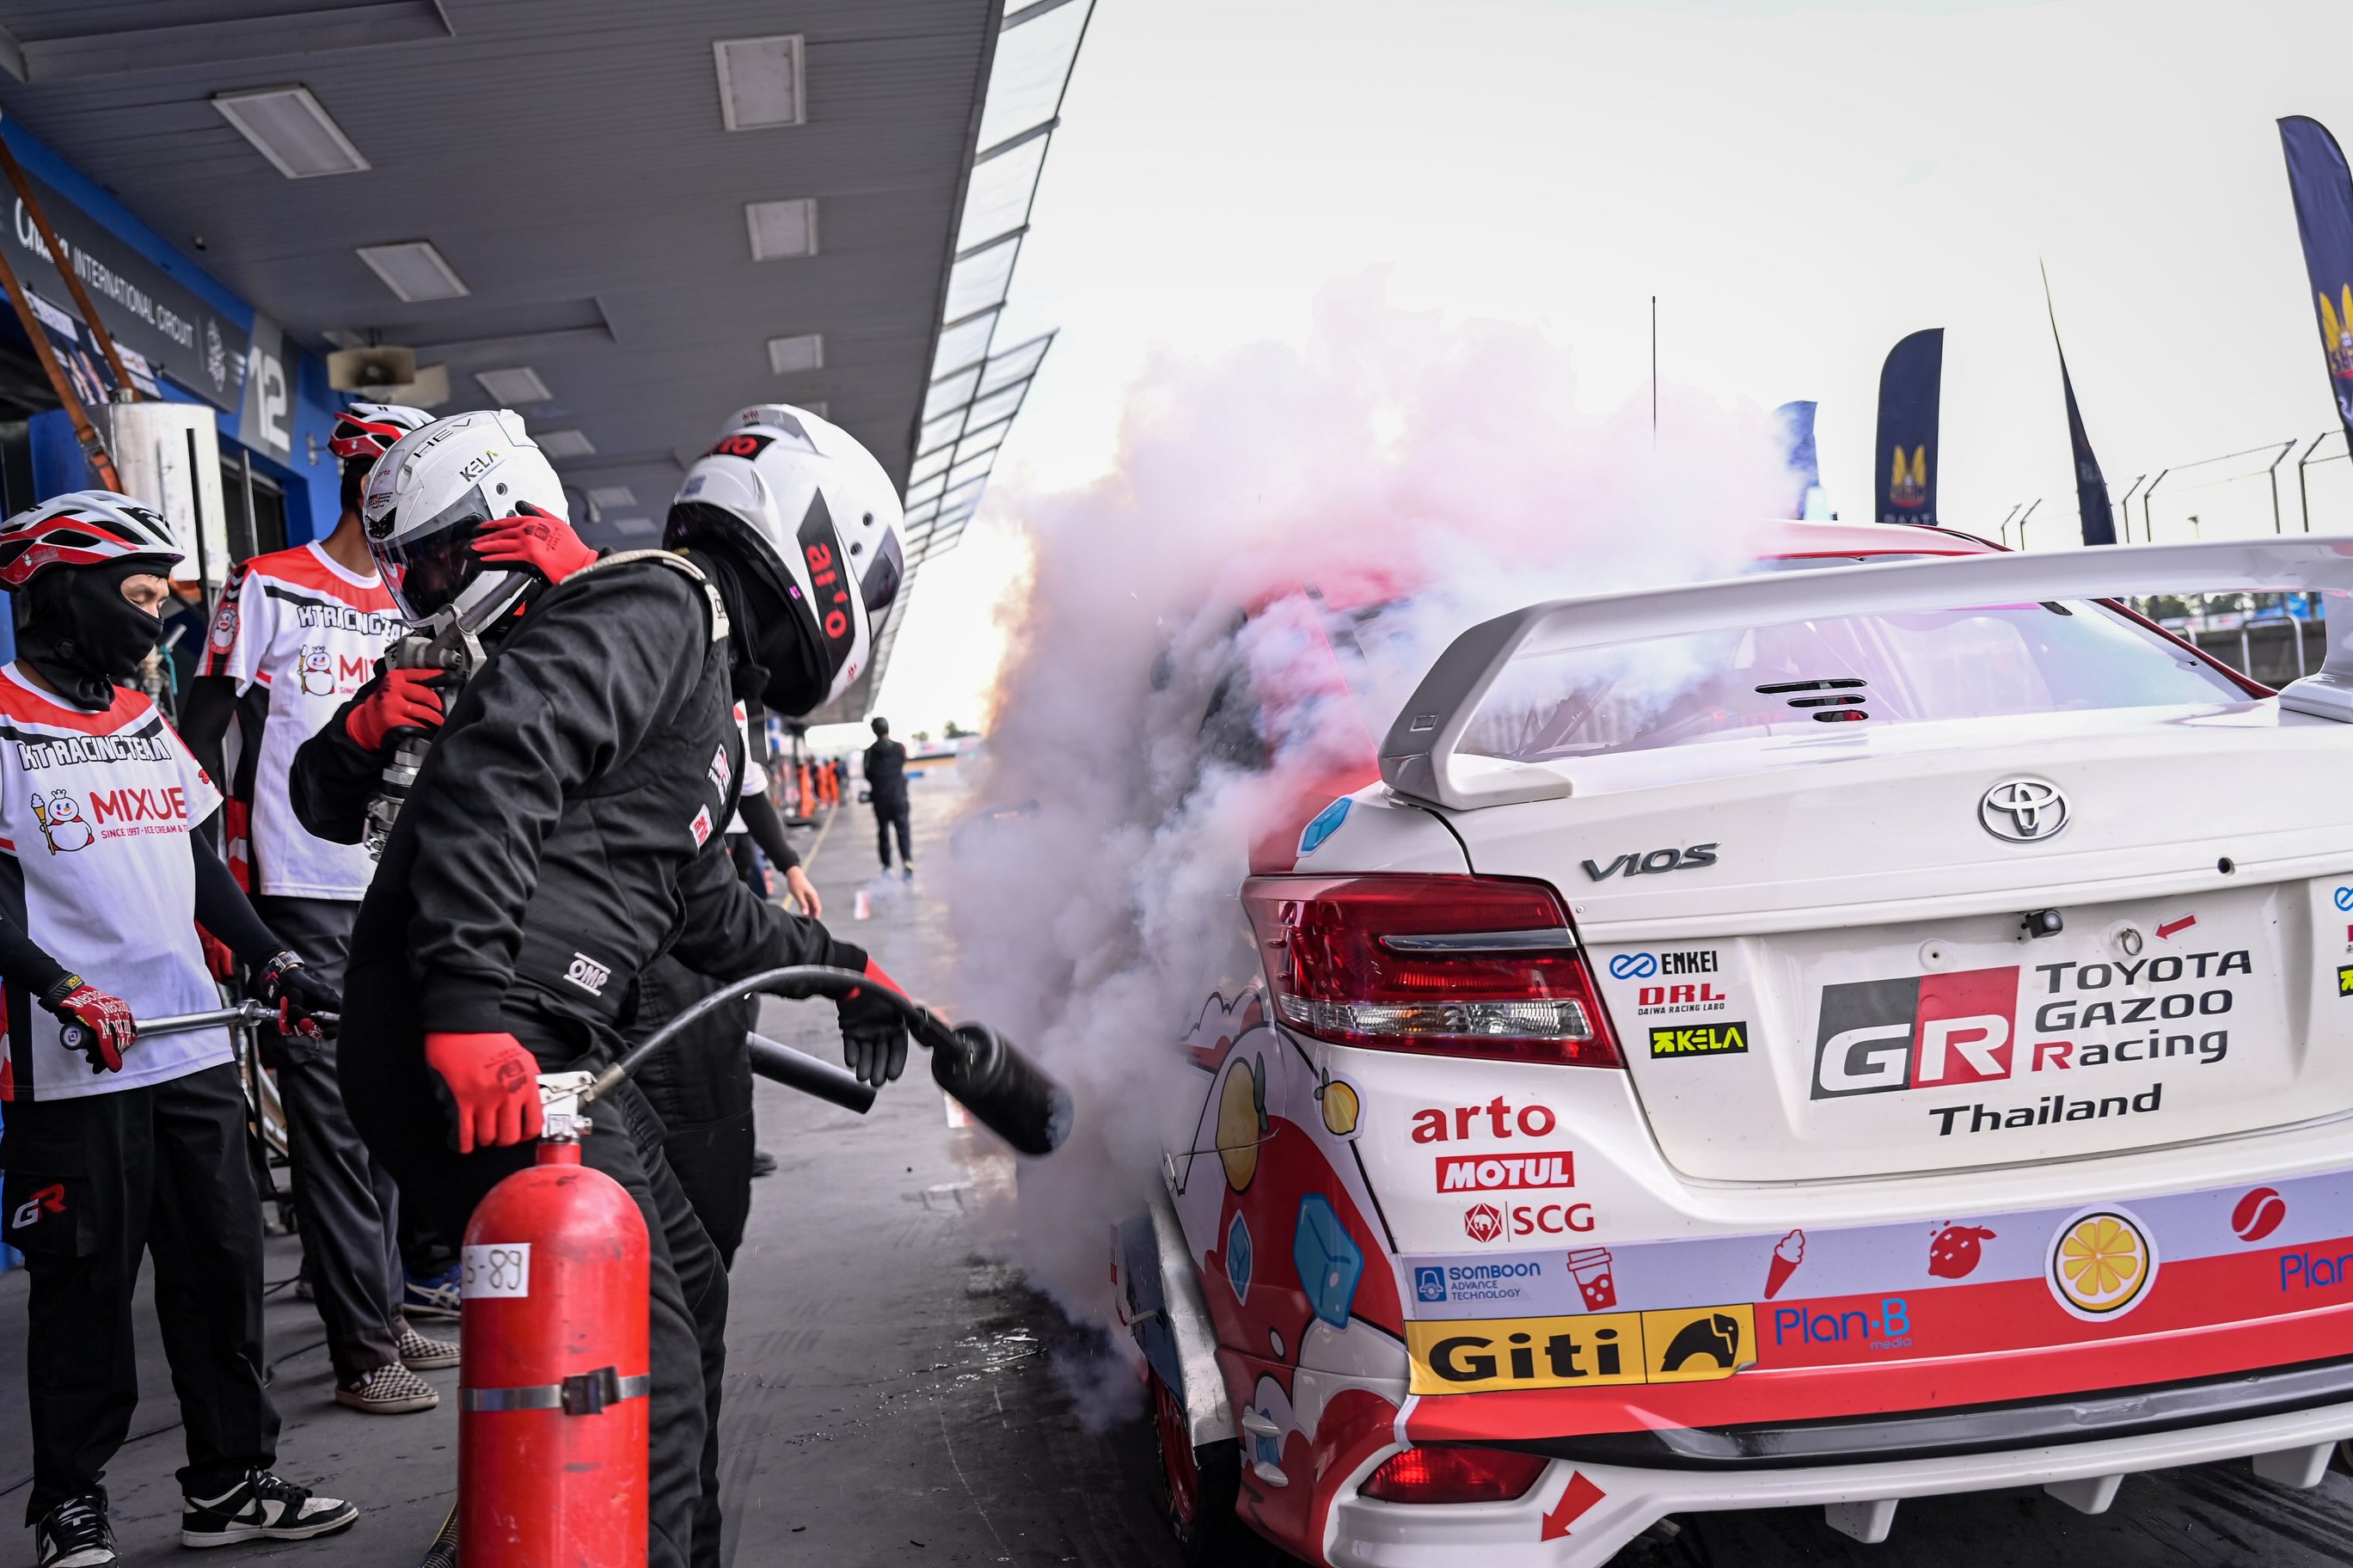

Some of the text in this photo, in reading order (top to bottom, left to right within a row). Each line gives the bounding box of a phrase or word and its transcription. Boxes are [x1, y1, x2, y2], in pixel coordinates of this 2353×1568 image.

[74, 247, 156, 325] INTERNATIONAL
[156, 303, 193, 349] CIRCUIT
[248, 346, 291, 452] 12
[17, 736, 173, 770] KT RACING TEAM
[89, 787, 187, 824] MIXUE
[101, 828, 126, 839] SINCE
[144, 825, 155, 834] ICE
[155, 824, 176, 835] CREAM
[1582, 842, 1720, 881] VIOS
[568, 959, 609, 989] OMP
[1661, 951, 1718, 975] ENKEI
[2035, 950, 2252, 994] TOYOTA
[1638, 1002, 1725, 1016] DAIWA RACING LABO
[1639, 983, 1725, 1006] DRL
[2034, 989, 2234, 1033] GAZOO
[1676, 1027, 1744, 1051] KELA
[1819, 1014, 2010, 1092] GR
[2031, 1030, 2229, 1072] Racing
[1412, 1095, 1555, 1144] arto
[1928, 1083, 2162, 1136] Thailand
[1443, 1157, 1570, 1190] MOTUL
[12, 1184, 67, 1229] GR
[1512, 1204, 1595, 1234] SCG
[1449, 1263, 1541, 1280] SOMBOON
[1451, 1280, 1498, 1290] ADVANCE
[1451, 1289, 1521, 1301] TECHNOLOGY
[1429, 1329, 1621, 1382] Giti
[1871, 1337, 1913, 1351] media
